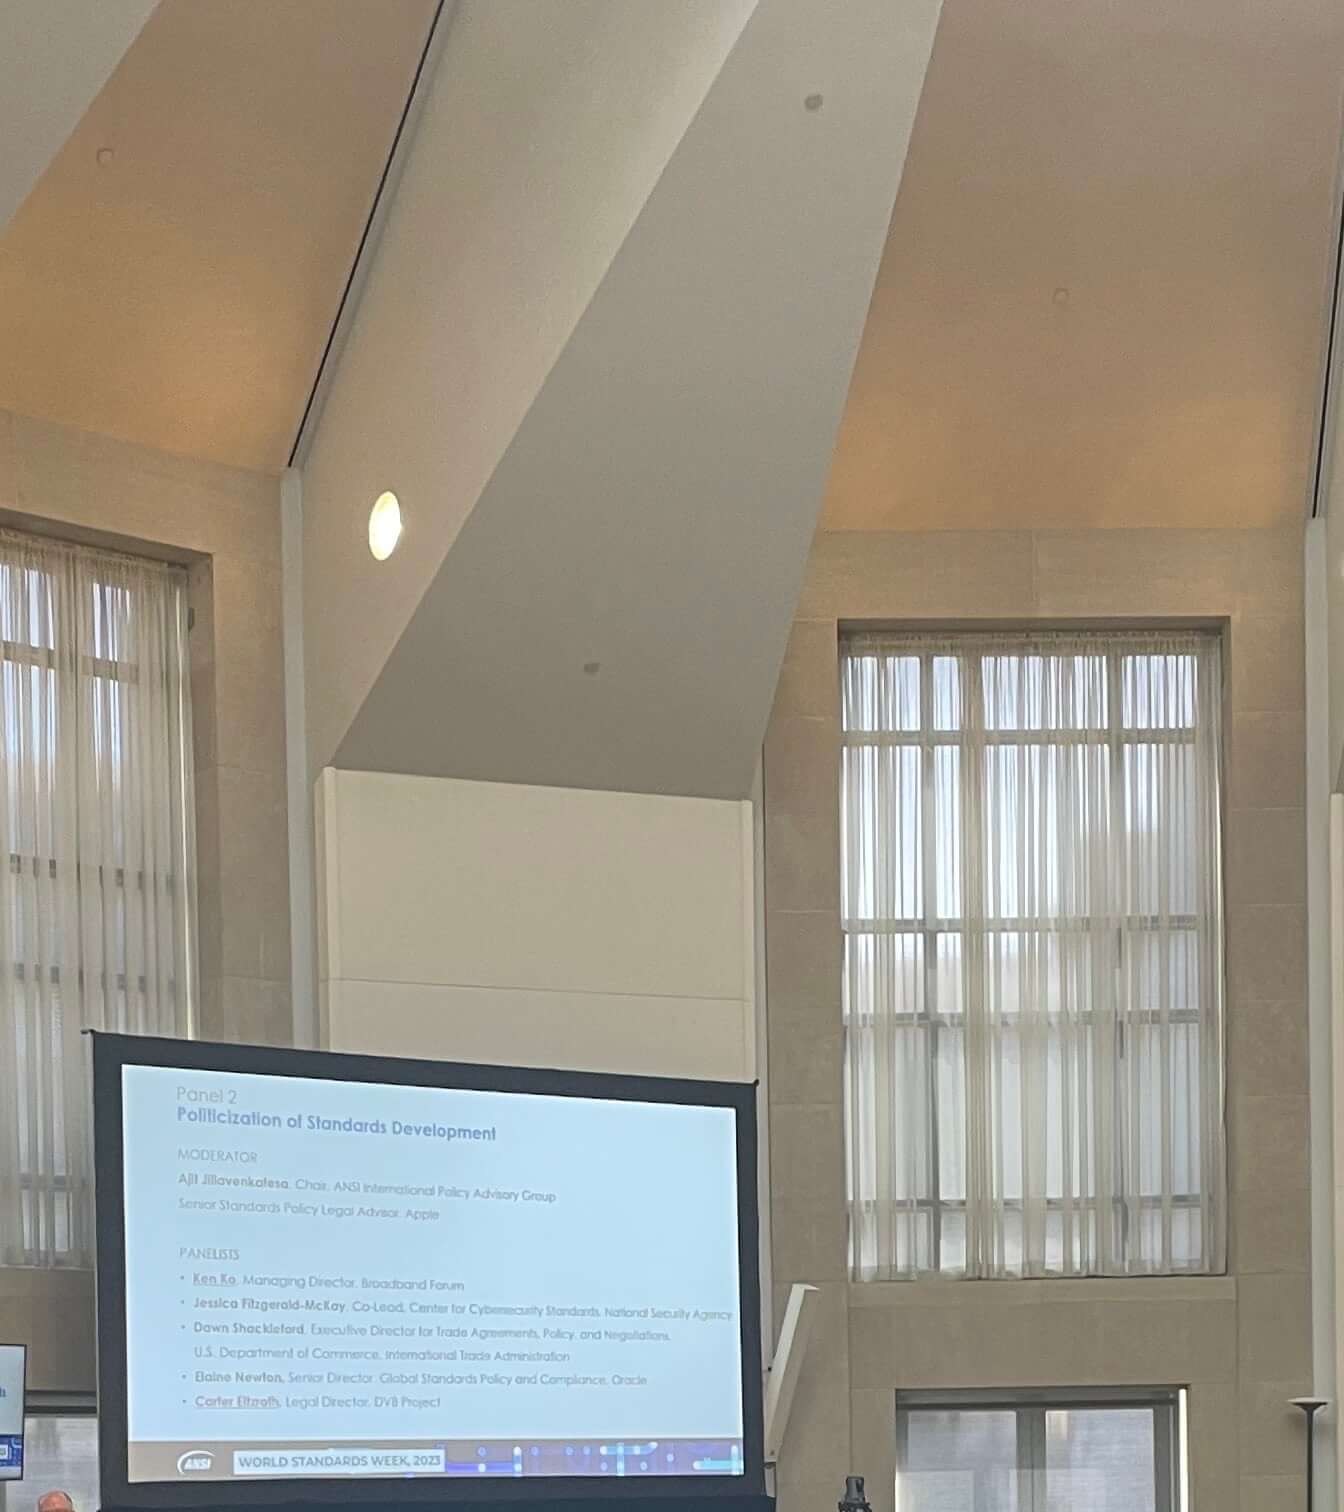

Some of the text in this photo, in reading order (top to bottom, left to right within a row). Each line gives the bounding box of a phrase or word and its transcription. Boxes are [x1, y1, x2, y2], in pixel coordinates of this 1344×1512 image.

[176, 1086, 238, 1104] Panel 2
[177, 1107, 497, 1141] Politicization of Standards Development
[177, 1149, 258, 1163] MODERATOR
[333, 1181, 360, 1193] ANSI
[363, 1182, 436, 1197] International
[438, 1185, 470, 1200] Policy
[472, 1187, 519, 1201] Advisory
[522, 1190, 557, 1203] Group
[178, 1198, 217, 1210] Senior
[219, 1198, 281, 1213] Standards
[283, 1202, 318, 1217] Policy
[321, 1204, 354, 1219] Legal
[405, 1208, 440, 1221] Apple
[179, 1247, 240, 1261] PANELISTS
[192, 1272, 217, 1286] Ken
[242, 1273, 306, 1289] Managing
[361, 1276, 427, 1291] Broadband
[429, 1279, 465, 1291] Forum
[193, 1297, 238, 1310] Jessica
[408, 1302, 449, 1314] Center
[451, 1303, 469, 1315] for
[604, 1307, 648, 1319] National
[651, 1308, 690, 1322] Security
[692, 1309, 733, 1322] Agency
[193, 1322, 230, 1334] Dawn
[311, 1324, 367, 1337] Executive
[370, 1325, 416, 1338] Director
[418, 1326, 434, 1338] for
[436, 1327, 468, 1339] Trade
[580, 1330, 601, 1341] and
[219, 1347, 293, 1361] Department
[296, 1347, 309, 1359] of
[385, 1348, 457, 1361] International
[459, 1350, 491, 1362] Trade
[494, 1351, 570, 1363] Administration
[288, 1372, 324, 1384] Senior
[379, 1373, 418, 1385] Global
[420, 1374, 478, 1386] Standards
[480, 1374, 512, 1387] Policy
[515, 1374, 537, 1385] and
[611, 1375, 647, 1386] Oracle
[194, 1396, 235, 1408] Carter
[285, 1396, 320, 1409] Legal
[374, 1396, 398, 1408] DVB
[401, 1396, 441, 1410] Project
[238, 1454, 441, 1469] WORLD STANDARDS WEEK, 2023
